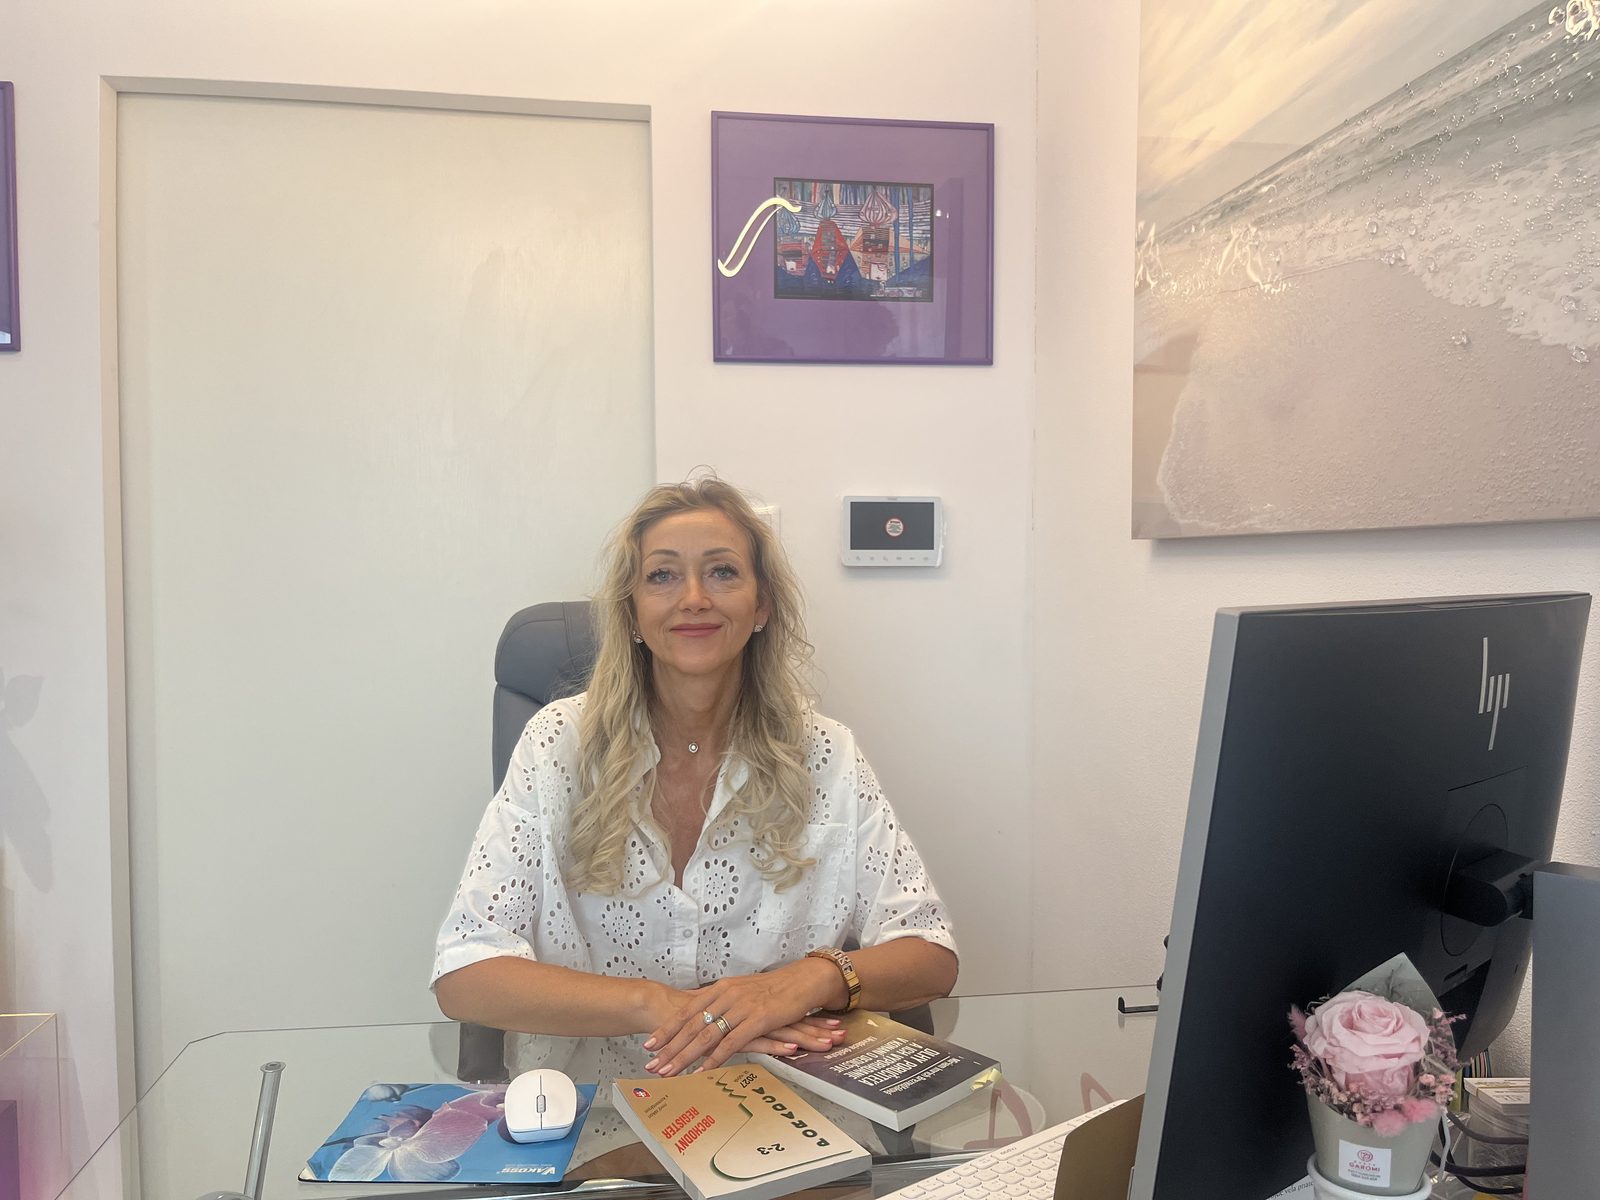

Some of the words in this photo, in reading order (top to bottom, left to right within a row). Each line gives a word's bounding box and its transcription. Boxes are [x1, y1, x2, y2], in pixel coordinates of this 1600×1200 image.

[1478, 637, 1510, 751] hp
[896, 1046, 917, 1056] ICH
[910, 1048, 940, 1063] DLHY
[739, 1072, 757, 1087] 2027
[661, 1107, 698, 1139] REGISTER
[751, 1085, 830, 1145] PORADCA
[674, 1115, 715, 1155] OBCHODNÝ
[756, 1143, 784, 1155] 2-3
